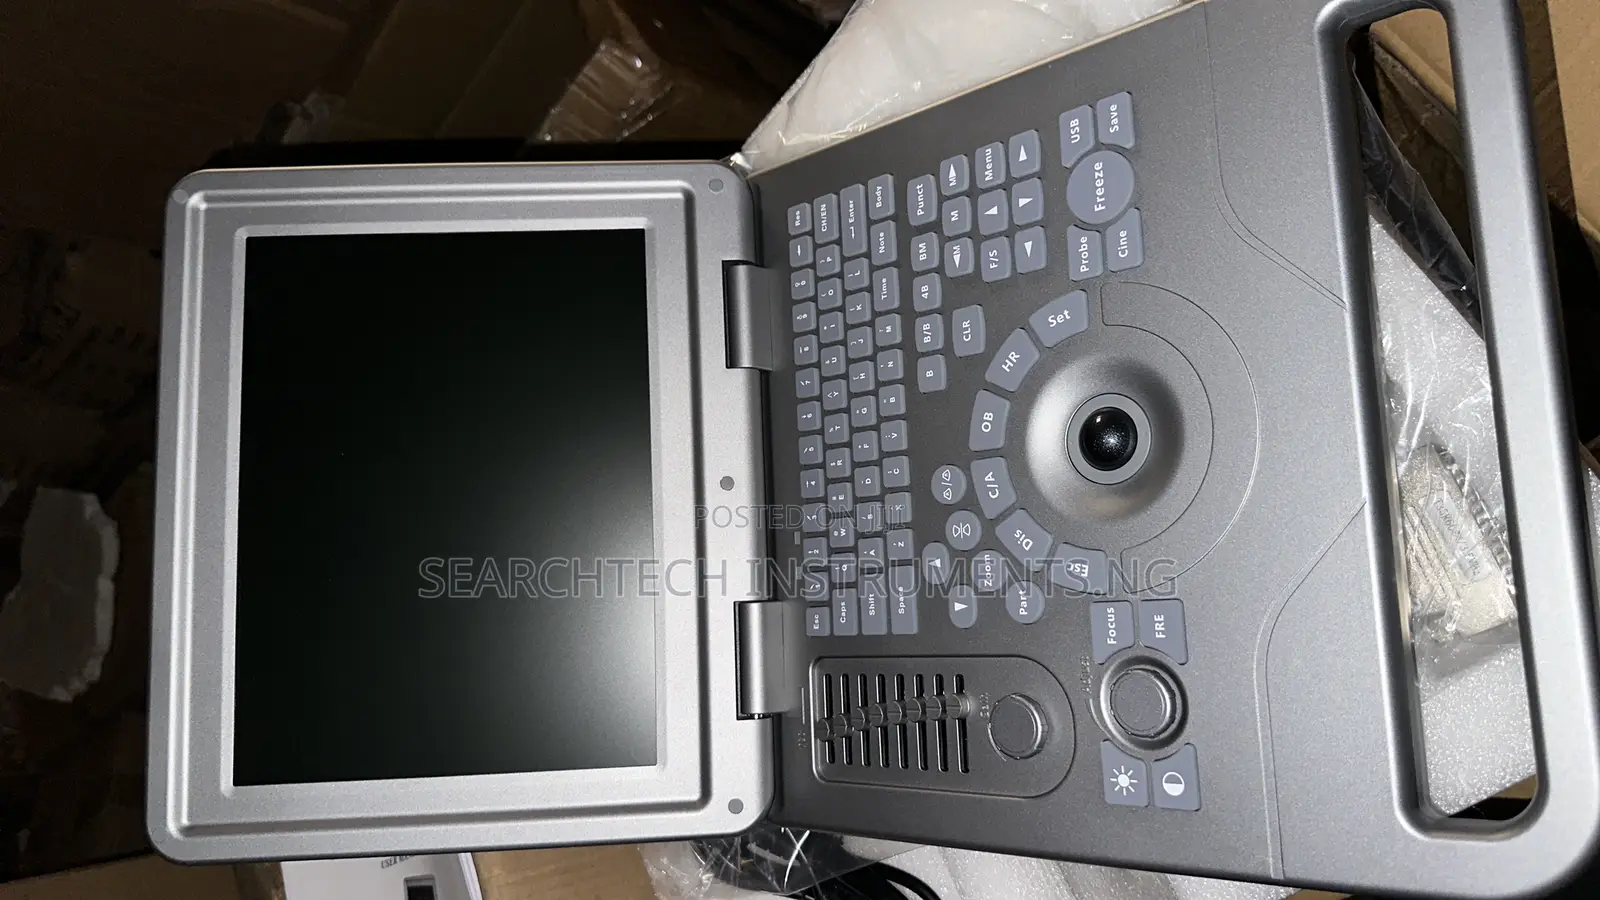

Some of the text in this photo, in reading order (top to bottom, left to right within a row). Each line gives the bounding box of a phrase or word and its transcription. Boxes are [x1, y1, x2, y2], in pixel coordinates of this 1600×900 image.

[1110, 105, 1119, 133] Save
[1070, 119, 1080, 143] USB
[985, 148, 993, 181] Menu
[948, 175, 957, 187] M
[1094, 162, 1105, 211] Freeze
[875, 186, 883, 208] Body
[916, 184, 924, 215] Punct
[820, 203, 828, 232] CH/EN
[950, 209, 959, 222] M
[918, 242, 927, 261] BM
[952, 244, 961, 256] M
[1079, 237, 1089, 272] Probe
[1118, 231, 1128, 257] Cine
[989, 250, 998, 268] F/S
[920, 284, 929, 299] 4B
[1048, 310, 1070, 327] Set
[923, 323, 931, 343] B/B
[963, 320, 971, 341] CLR
[925, 369, 934, 378] B
[1002, 352, 1020, 372] HR
[982, 412, 993, 432] OB
[985, 472, 999, 498] C/A
[1014, 530, 1033, 550] Dis
[984, 555, 993, 586] Zoom
[1067, 563, 1089, 577] Esc
[868, 593, 876, 616] Shift
[896, 585, 905, 614] Space
[1019, 590, 1027, 615] Part
[839, 601, 847, 624] Caps
[1107, 608, 1116, 644] Focus
[1154, 615, 1166, 638] FRE
